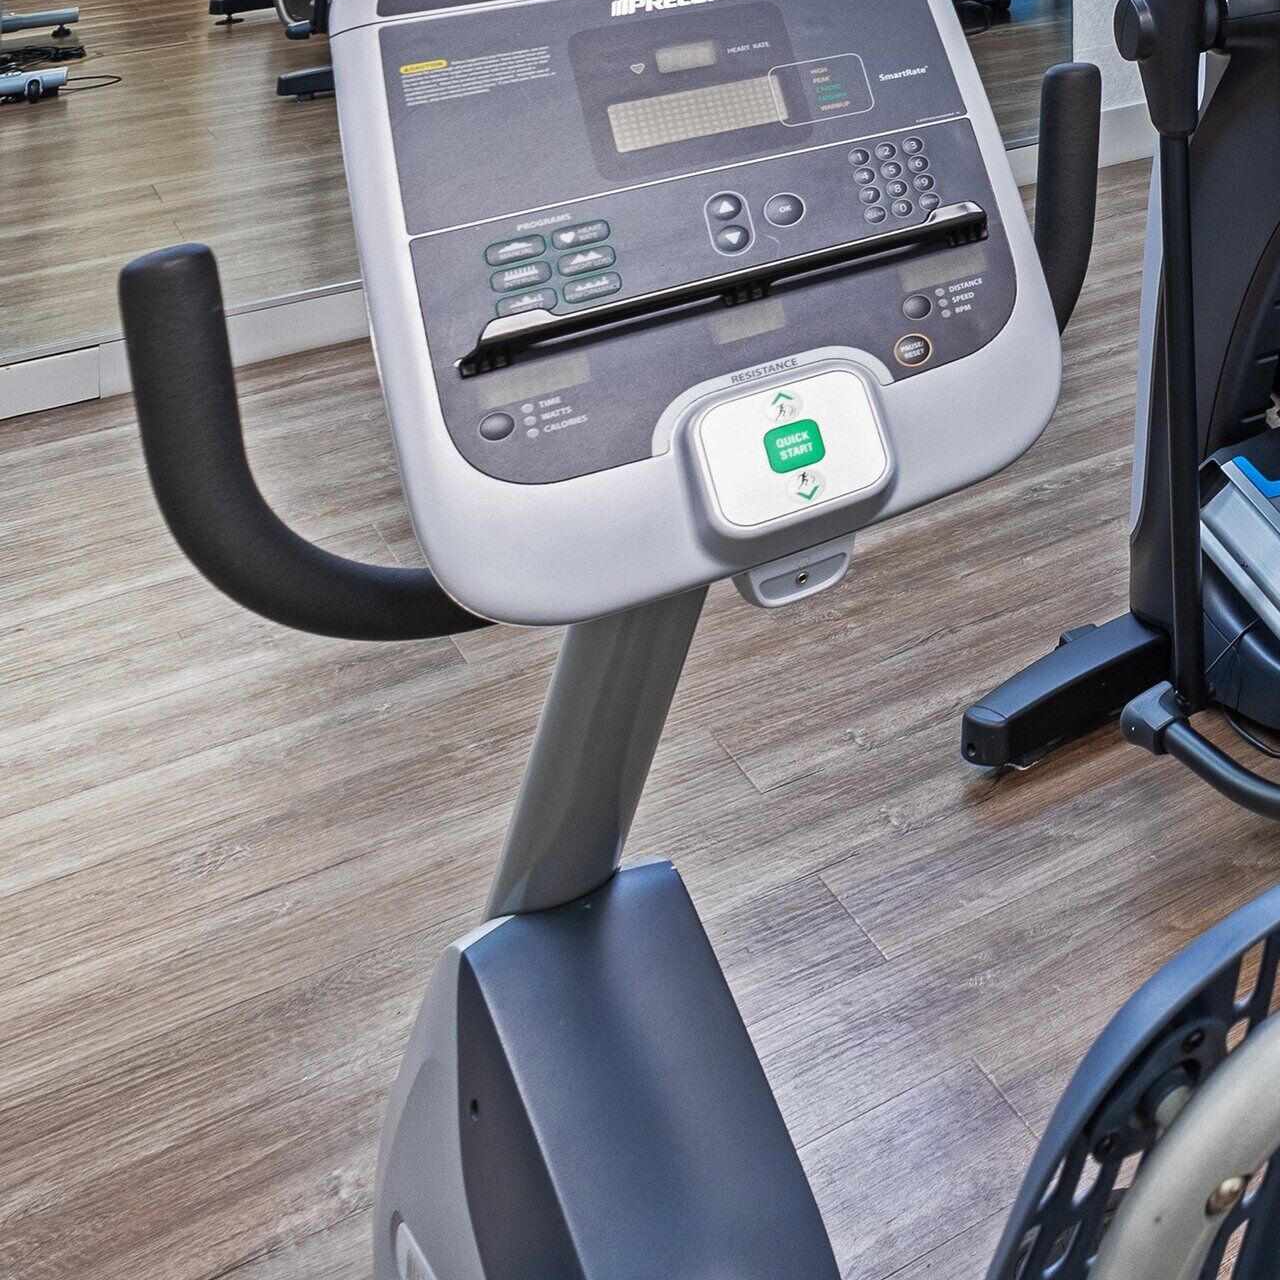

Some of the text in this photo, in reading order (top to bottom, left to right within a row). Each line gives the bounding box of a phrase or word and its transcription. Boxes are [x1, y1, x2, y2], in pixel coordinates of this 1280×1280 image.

[727, 41, 770, 54] HEART RATE
[884, 146, 891, 155] 2
[910, 141, 918, 150] 3
[889, 165, 896, 174] 5
[915, 158, 922, 168] 6
[867, 177, 928, 200] 7 8 9
[778, 204, 792, 213] OK
[899, 203, 907, 213] 0
[517, 213, 572, 231] PROGRAMS
[948, 277, 983, 293] DISTANCE
[951, 291, 975, 303] SPEED
[954, 304, 972, 314] RPM
[903, 348, 924, 359] RESET
[730, 358, 799, 384] RESISTANCE
[539, 396, 562, 408] TIME
[540, 406, 572, 420] WATTS
[543, 414, 589, 433] CALORIES
[775, 430, 810, 449] QUICK
[779, 442, 813, 461] START
